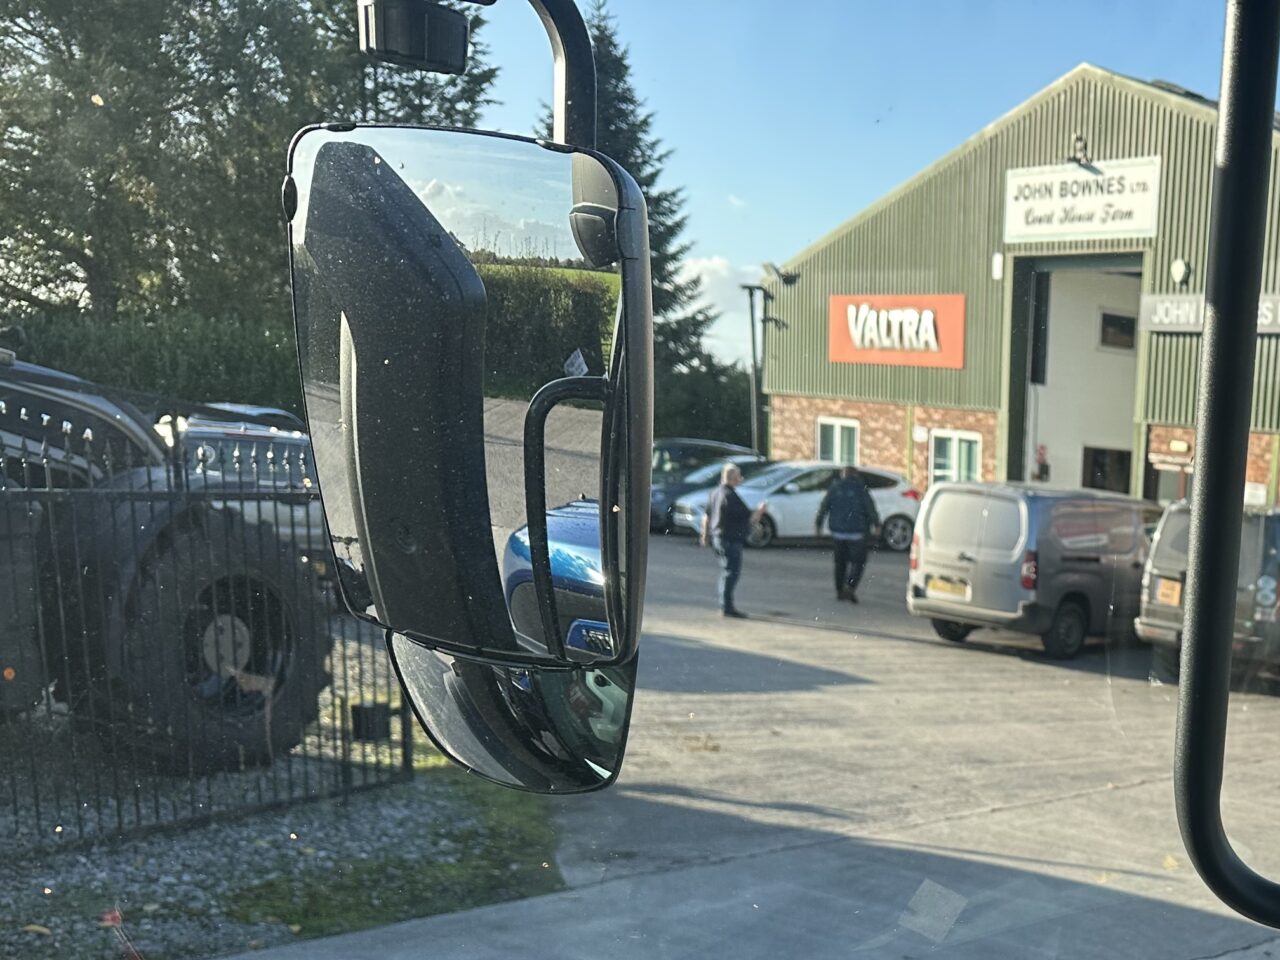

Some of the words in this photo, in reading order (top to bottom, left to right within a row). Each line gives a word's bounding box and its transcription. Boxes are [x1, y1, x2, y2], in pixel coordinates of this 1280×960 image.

[1014, 182, 1054, 201] JOHN
[1059, 176, 1126, 198] BOWNES
[1151, 301, 1197, 325] JOHN
[847, 303, 941, 352] VALTRA
